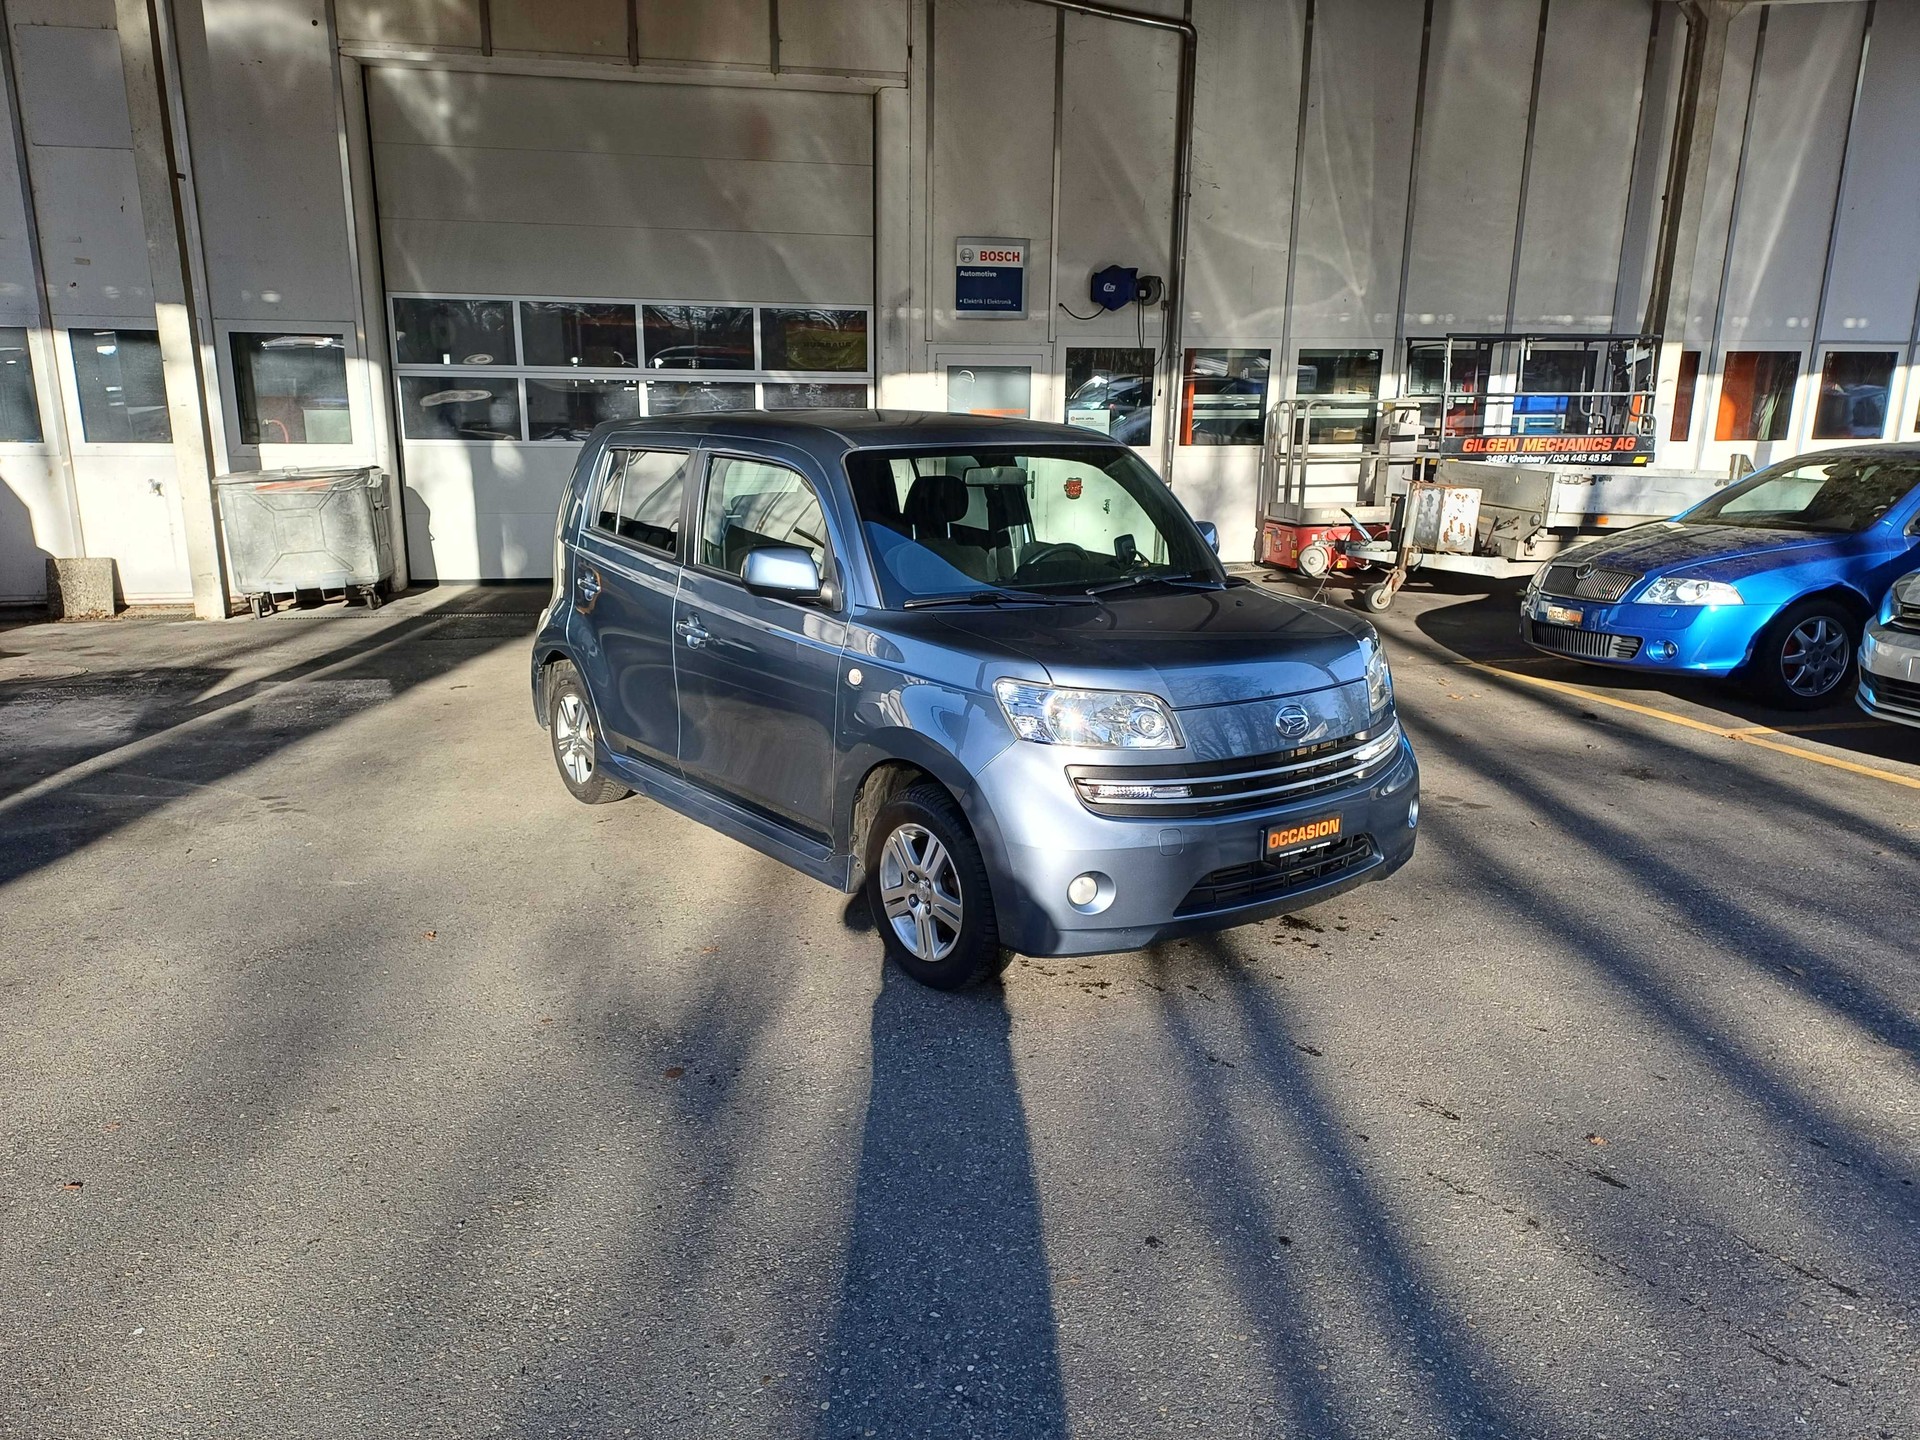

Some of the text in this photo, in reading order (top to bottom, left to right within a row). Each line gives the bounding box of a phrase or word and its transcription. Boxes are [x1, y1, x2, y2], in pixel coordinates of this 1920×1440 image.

[980, 251, 1020, 262] BOSCH
[960, 270, 997, 278] Automotive
[1462, 437, 1637, 452] GILGEN MECHANICS AG
[1486, 454, 1508, 464] 3422
[1508, 454, 1547, 465] Kirchberg
[1553, 454, 1569, 463] 034
[1571, 454, 1587, 462] 445
[1588, 454, 1600, 462] 45
[1548, 609, 1581, 623] OCCASION
[1269, 818, 1340, 849] OCCASION
